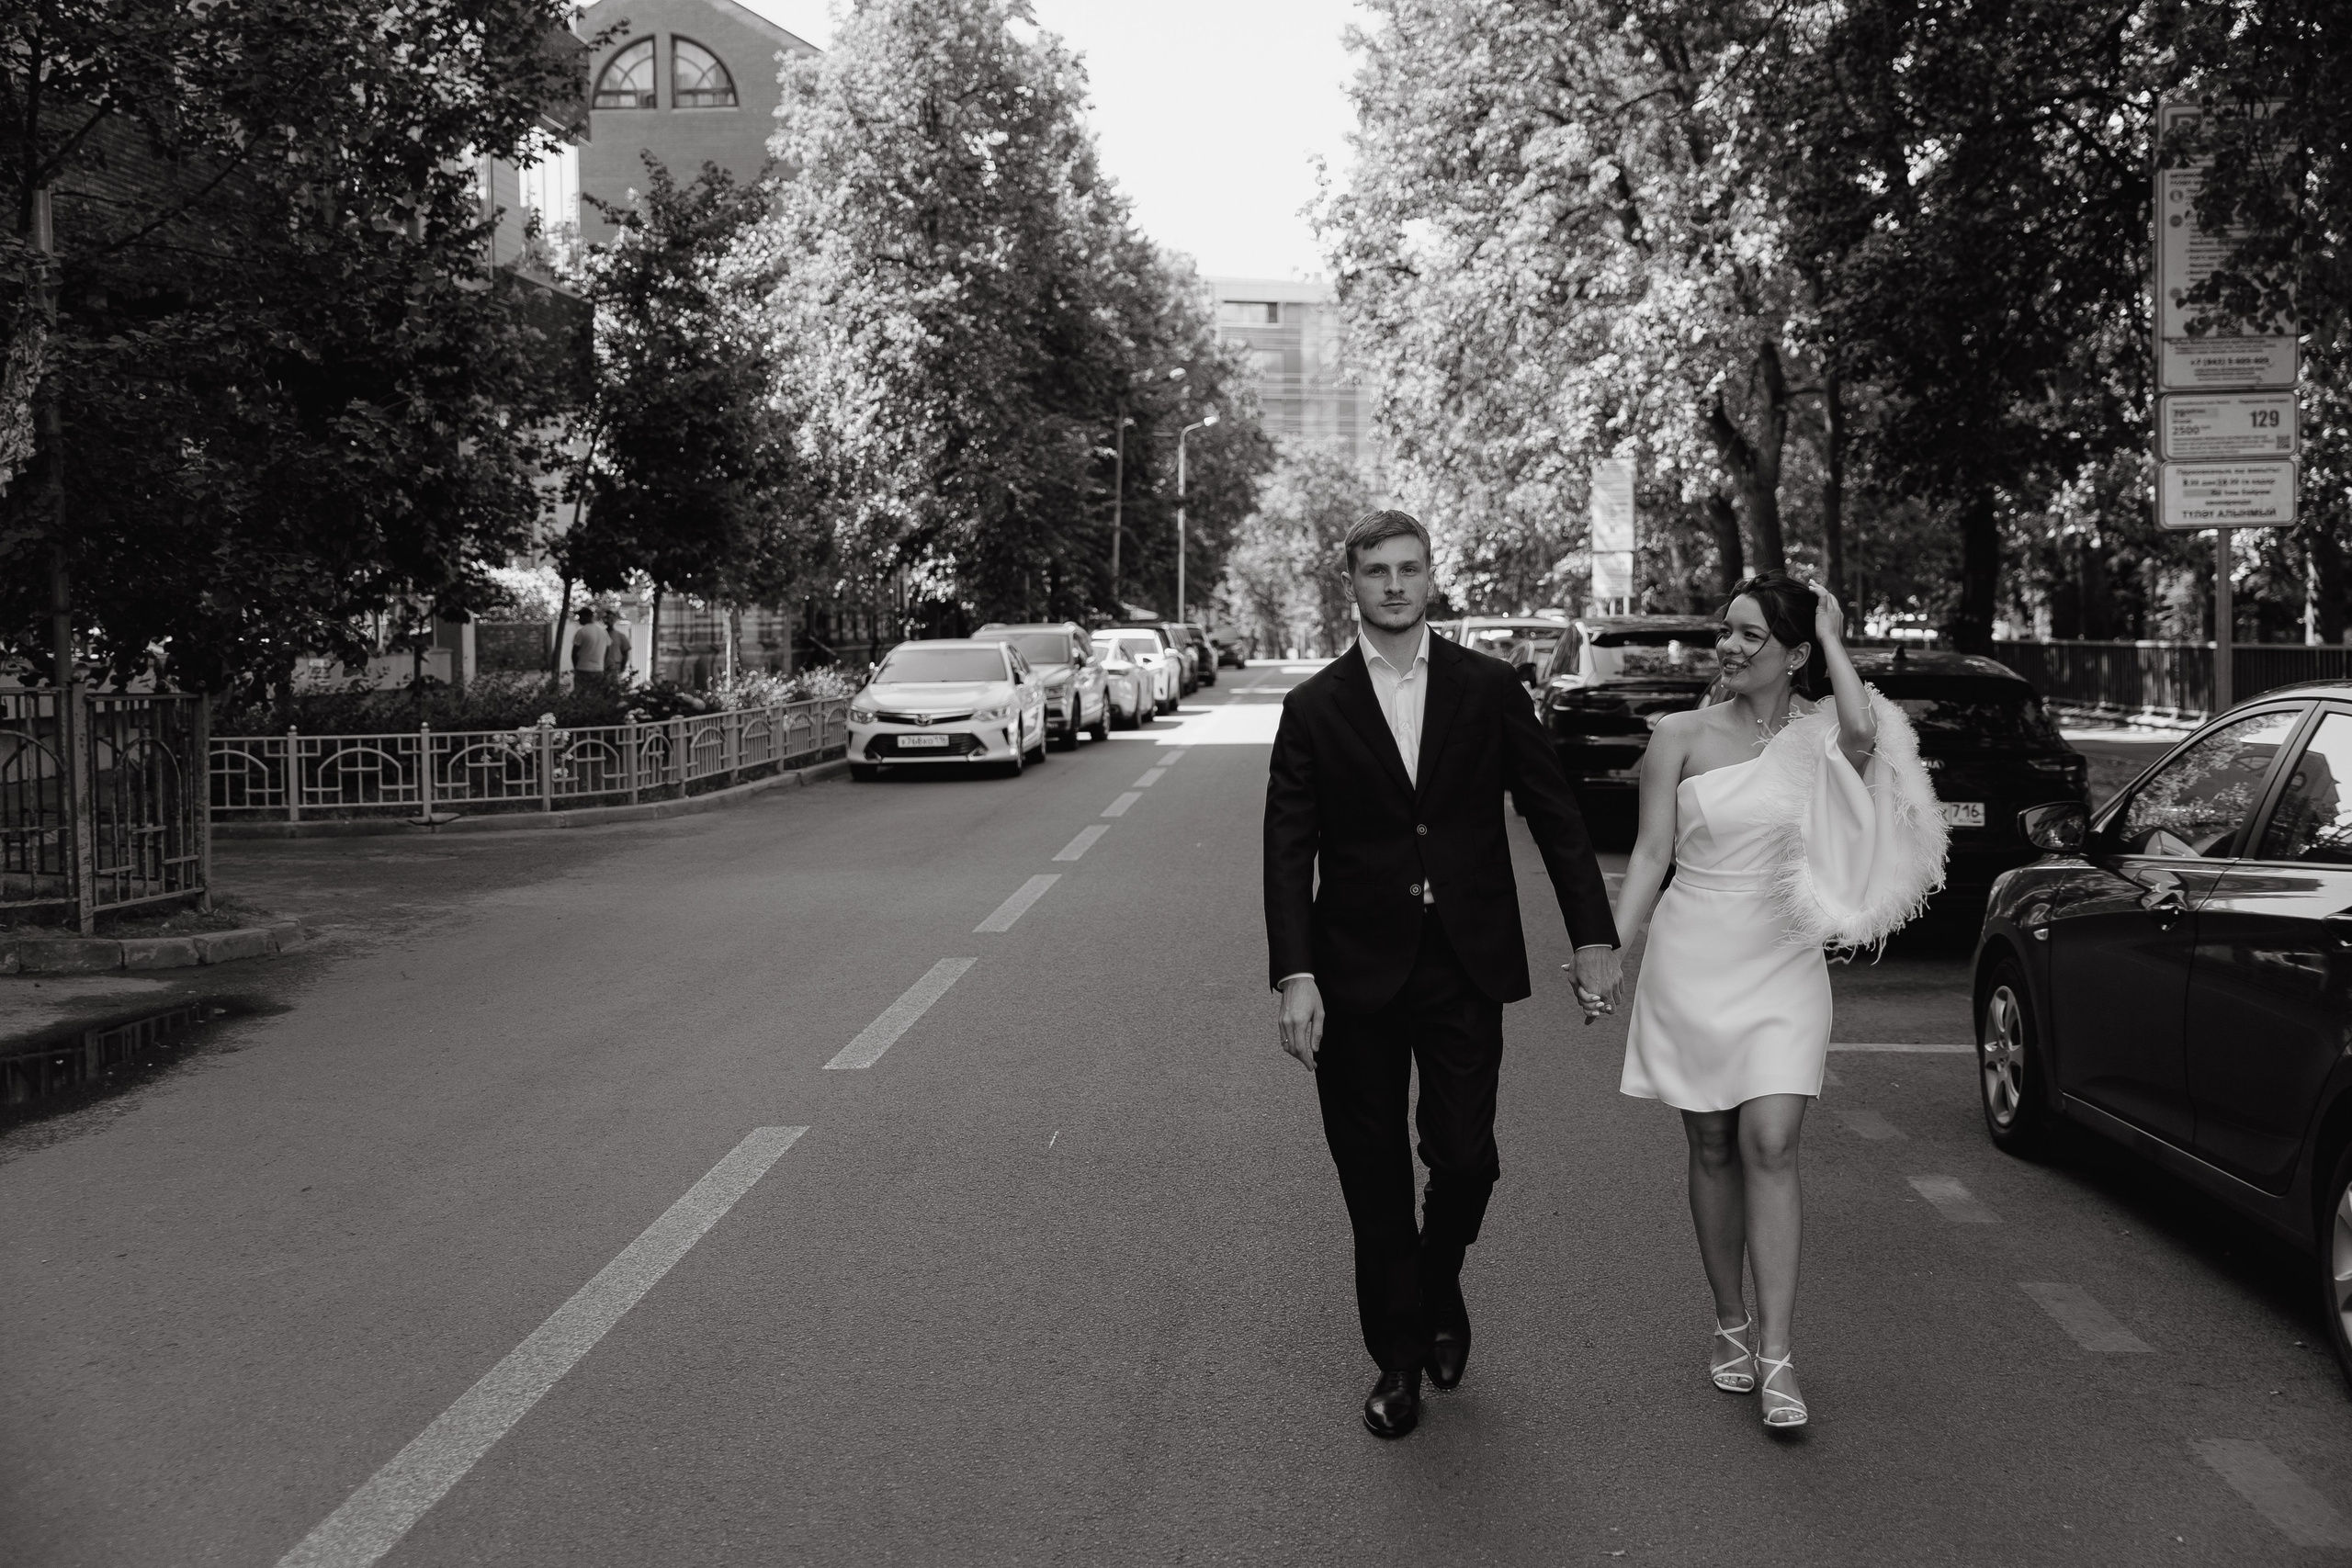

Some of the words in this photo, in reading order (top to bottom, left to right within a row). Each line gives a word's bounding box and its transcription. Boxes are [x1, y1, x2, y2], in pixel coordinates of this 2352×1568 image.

[2250, 409, 2279, 427] 129
[2172, 425, 2200, 435] 2500
[1952, 804, 1979, 818] 716
